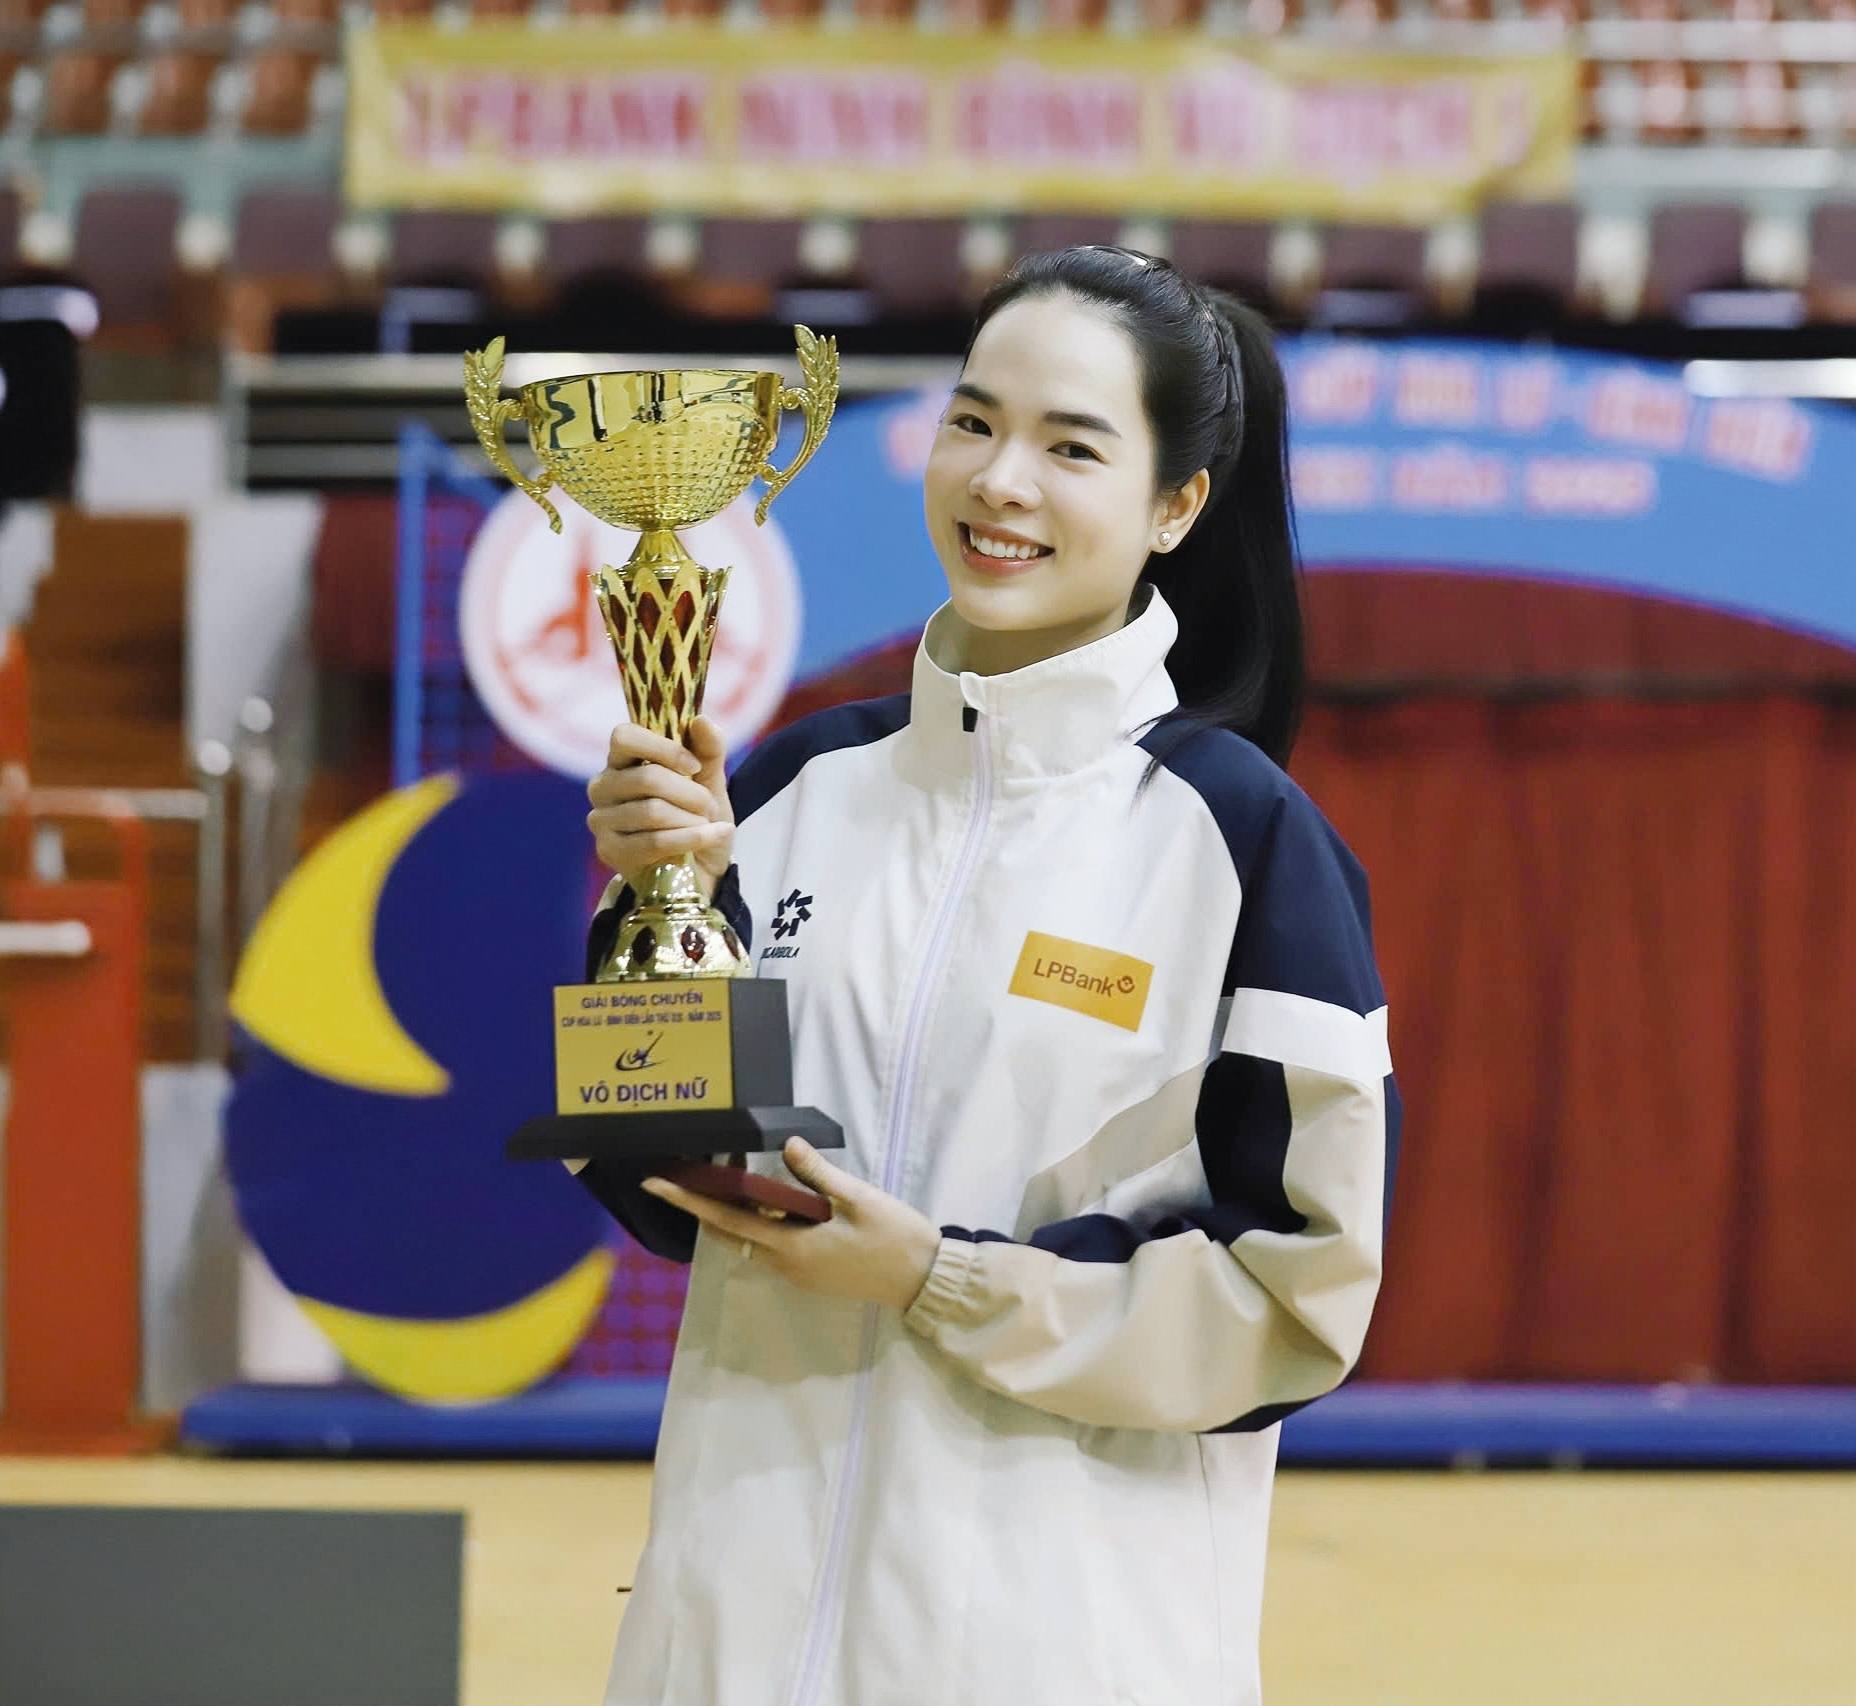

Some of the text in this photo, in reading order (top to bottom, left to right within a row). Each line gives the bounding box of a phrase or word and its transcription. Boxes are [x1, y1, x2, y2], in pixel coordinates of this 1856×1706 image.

[1033, 958, 1115, 997] LPBank
[580, 1076, 708, 1106] VÔ ĐỊCH NỮ
